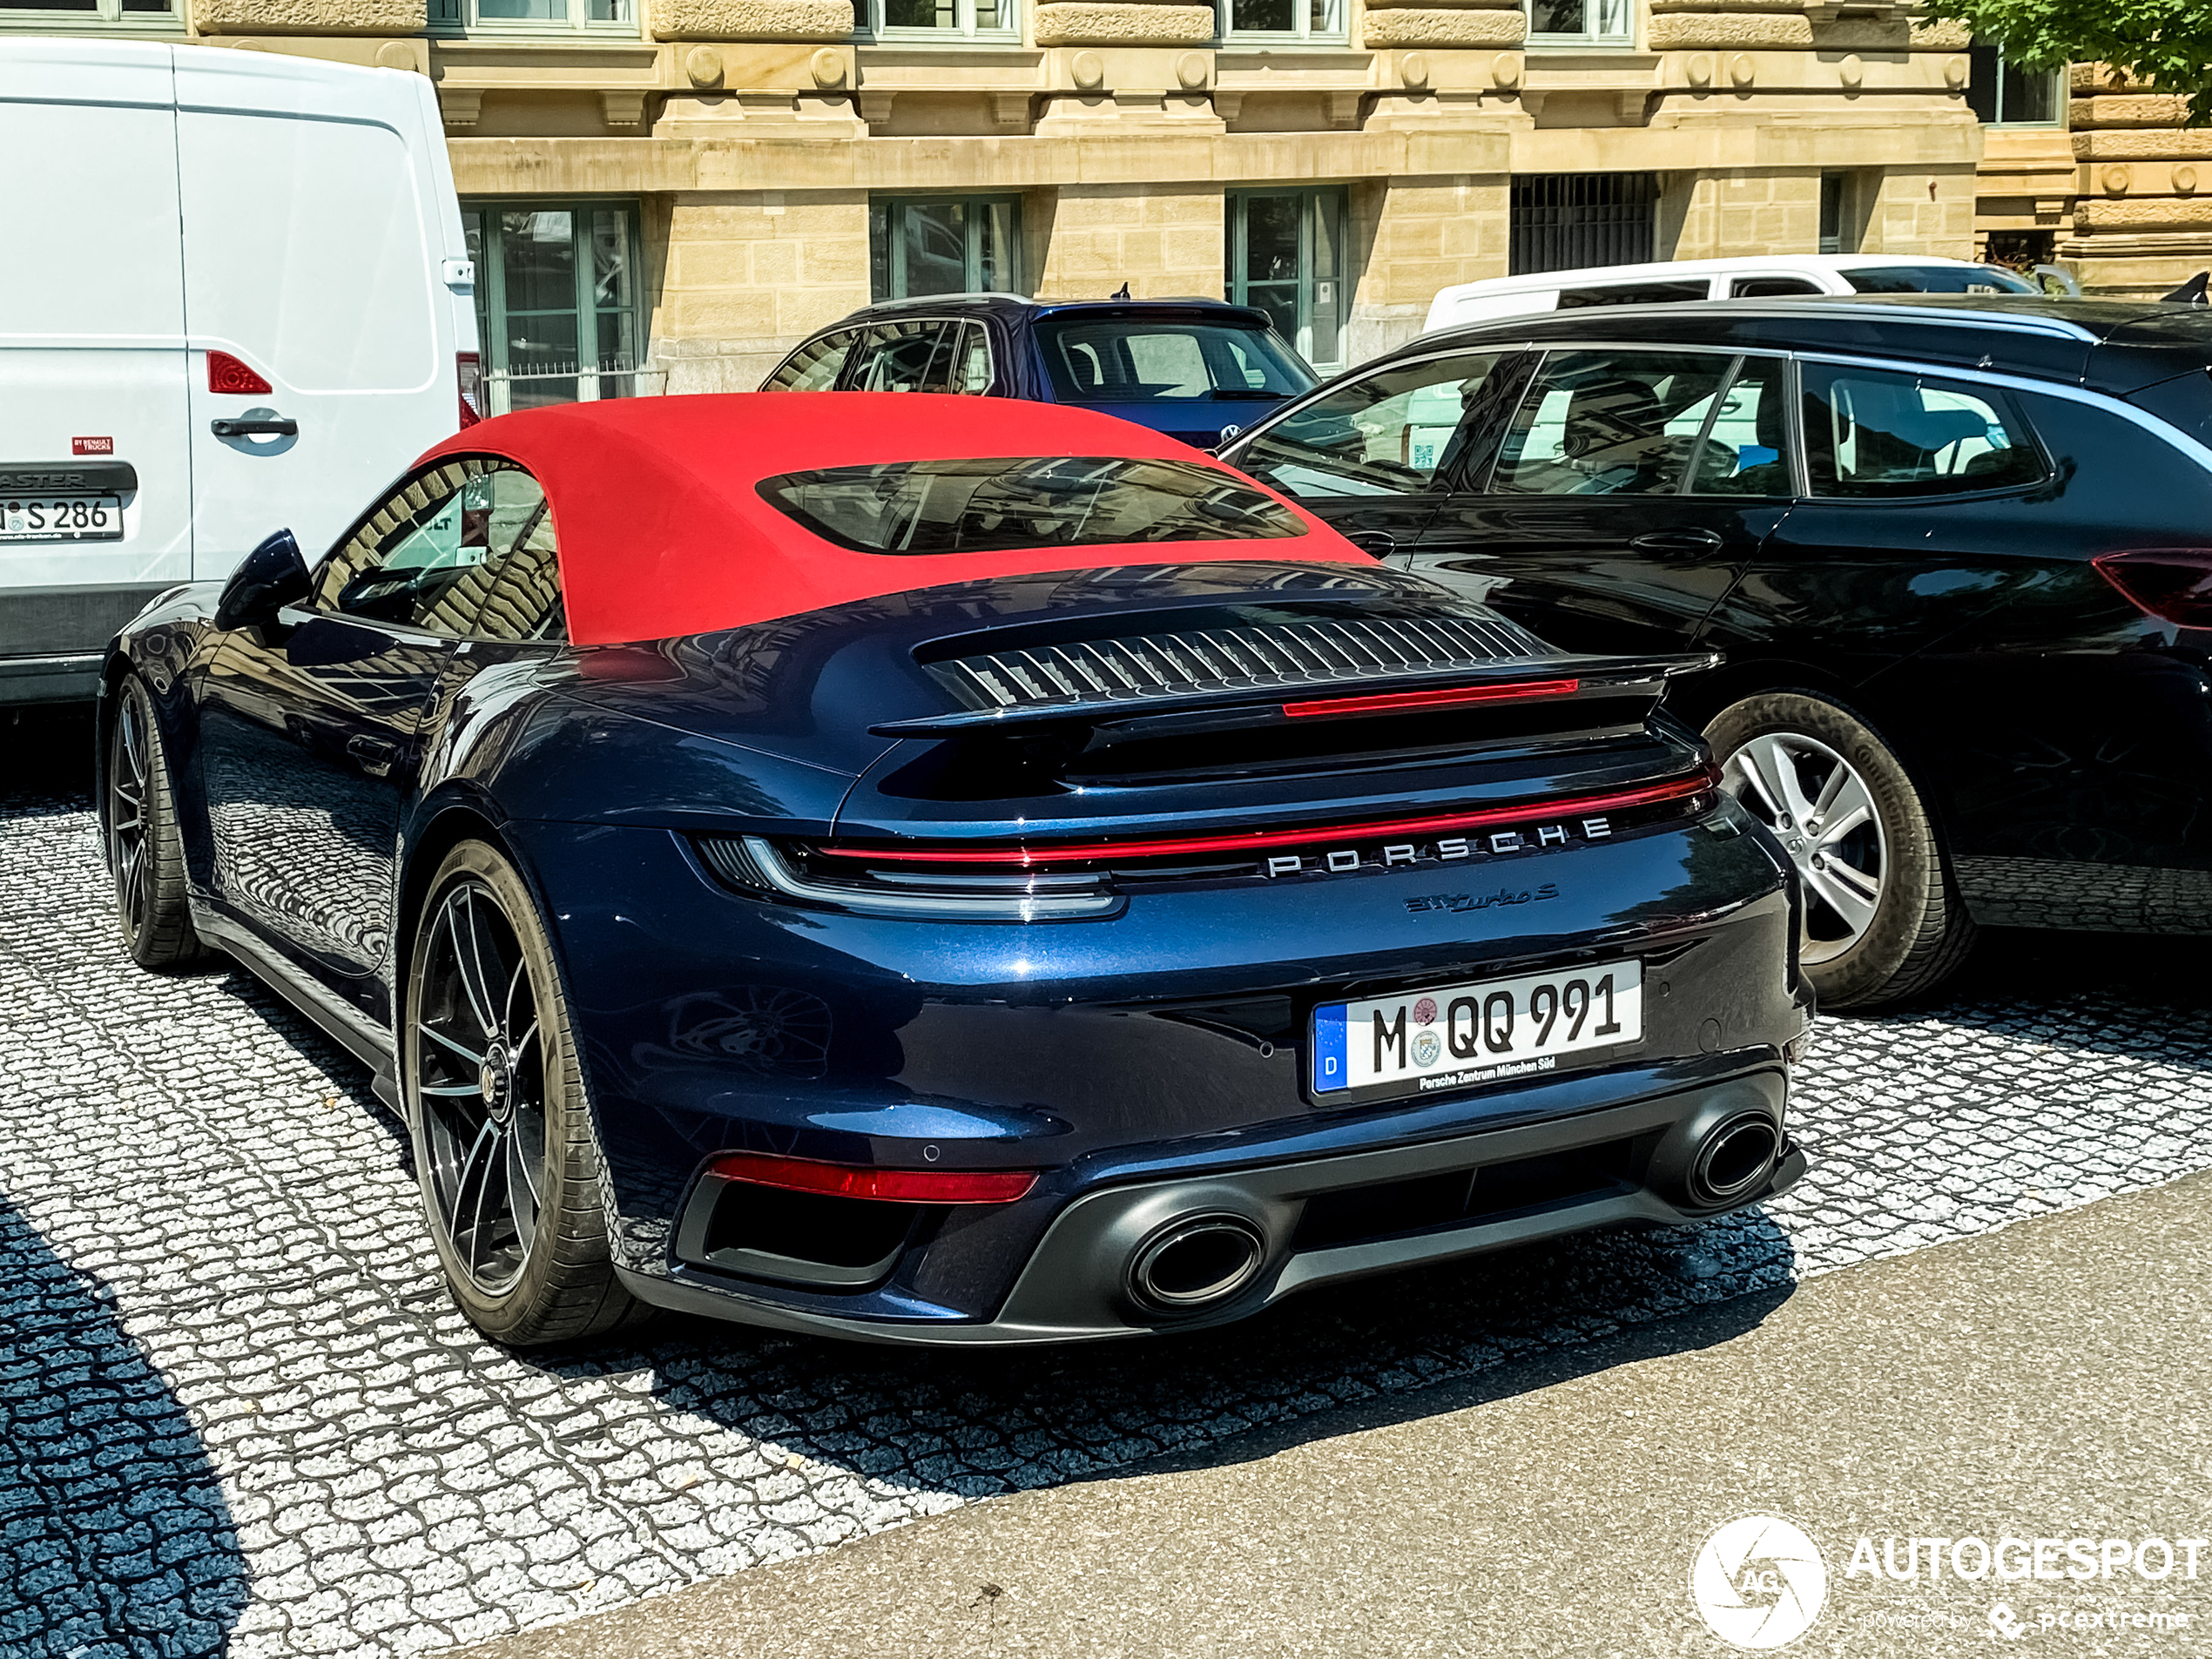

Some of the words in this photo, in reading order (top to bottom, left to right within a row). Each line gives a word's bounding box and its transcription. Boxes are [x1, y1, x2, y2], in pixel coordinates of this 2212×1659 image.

[27, 502, 45, 529] S
[54, 501, 107, 529] 286
[1268, 817, 1612, 879] PORSCHE
[1534, 882, 1560, 901] S
[1372, 1005, 1407, 1073] M
[1447, 990, 1515, 1060] QQ
[1529, 973, 1622, 1048] 991
[1325, 1056, 1338, 1076] D
[1420, 1074, 1457, 1090] Porsche
[1457, 1068, 1496, 1084] Zentrum
[1496, 1062, 1538, 1078] München
[1537, 1056, 1556, 1070] Süd
